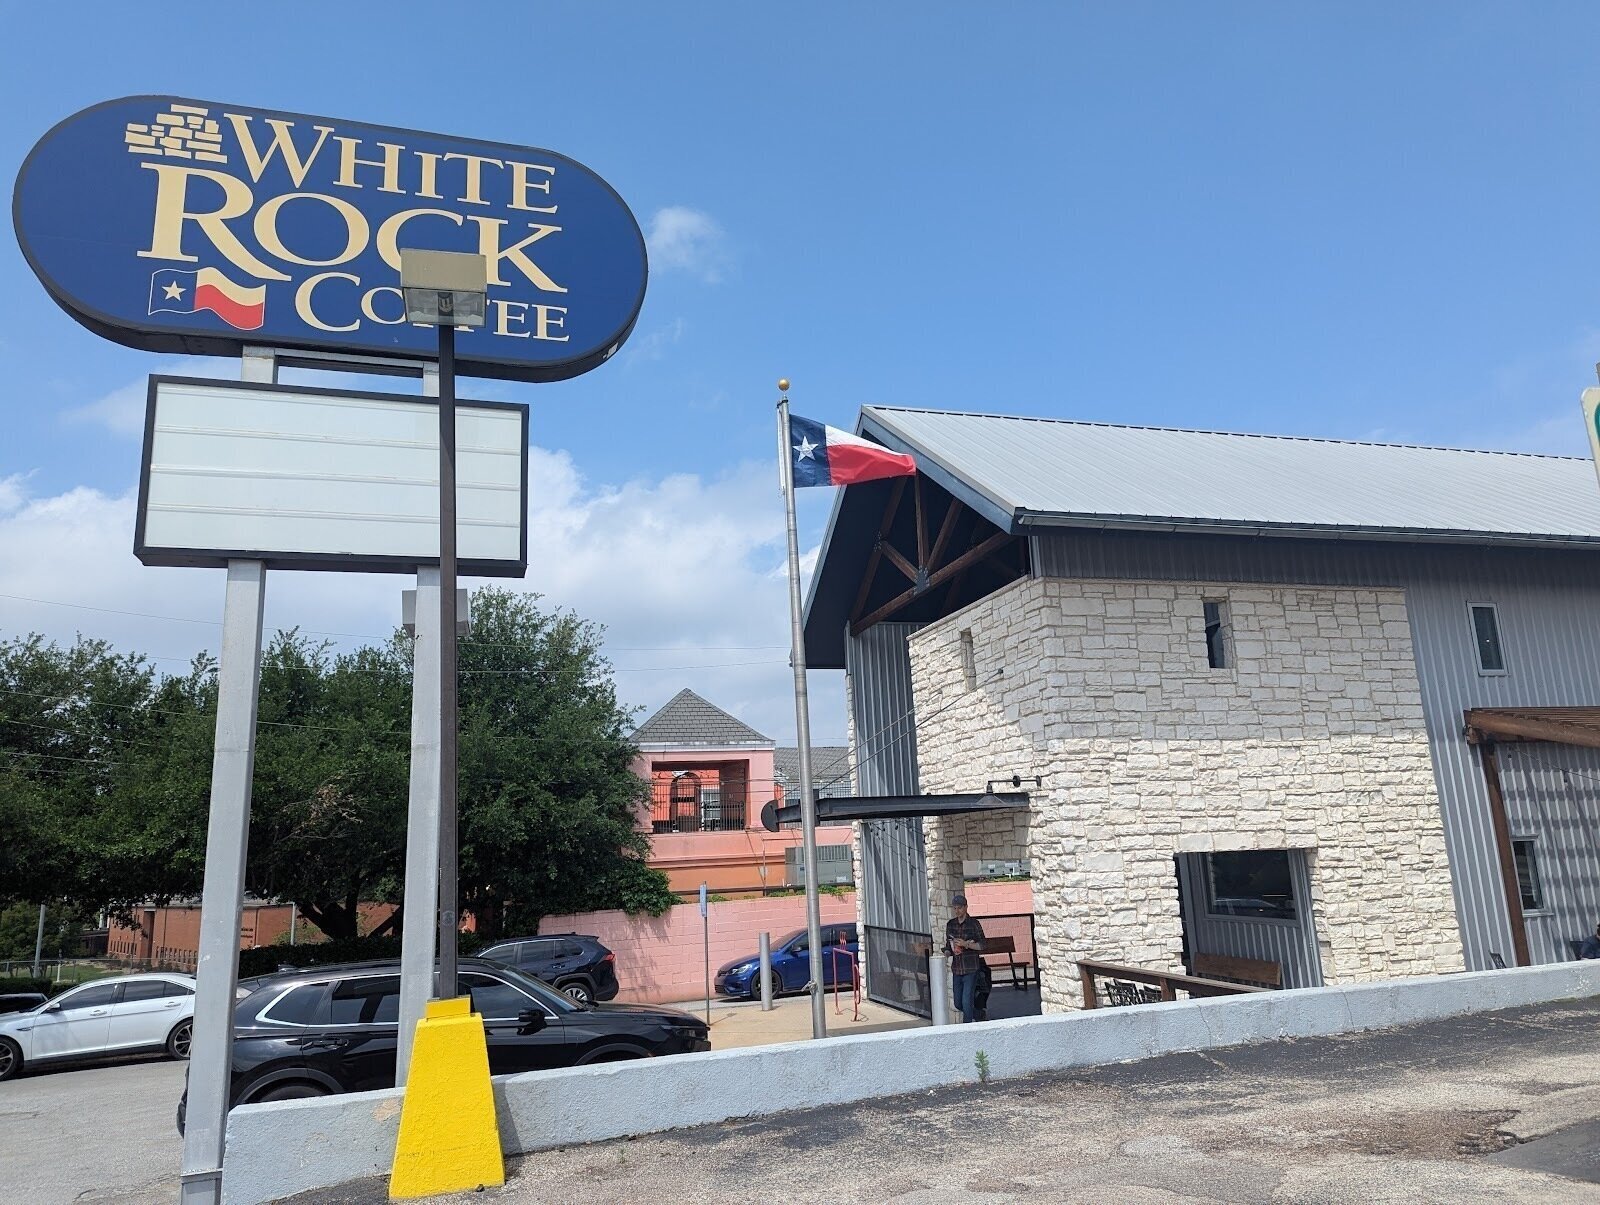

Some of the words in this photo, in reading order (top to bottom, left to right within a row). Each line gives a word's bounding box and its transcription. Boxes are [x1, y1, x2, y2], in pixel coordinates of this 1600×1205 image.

[224, 113, 558, 214] WHITE
[137, 162, 568, 293] ROCK
[295, 272, 569, 342] COEE
